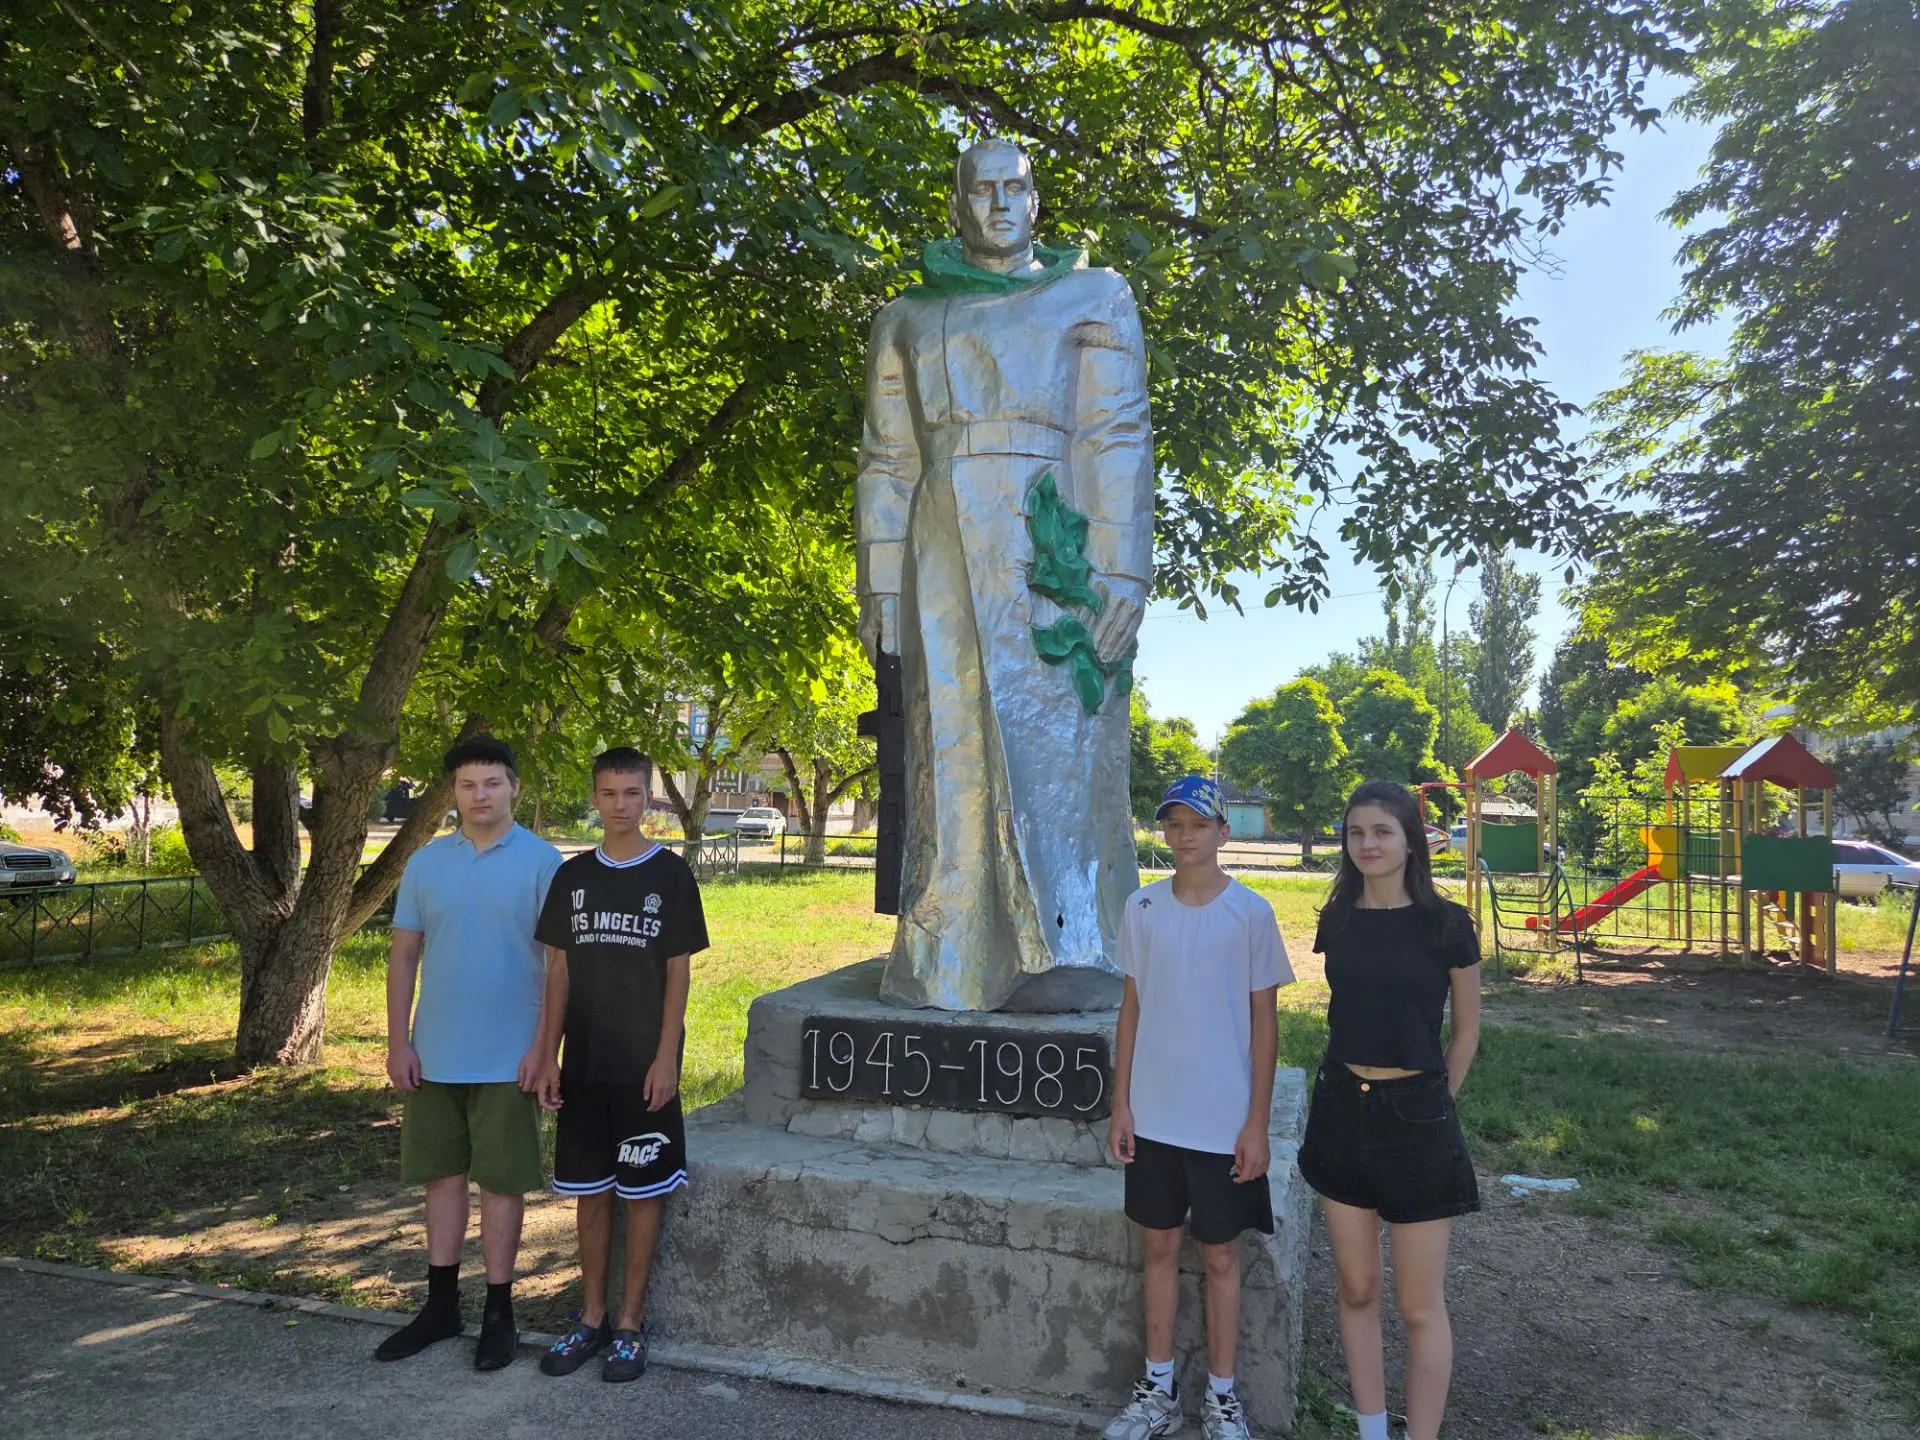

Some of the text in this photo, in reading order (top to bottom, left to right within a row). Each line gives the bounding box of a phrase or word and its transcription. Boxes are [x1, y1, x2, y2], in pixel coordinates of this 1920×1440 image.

[571, 888, 585, 912] 10
[600, 933, 647, 948] CHAMPIONS
[617, 1141, 662, 1165] RACE
